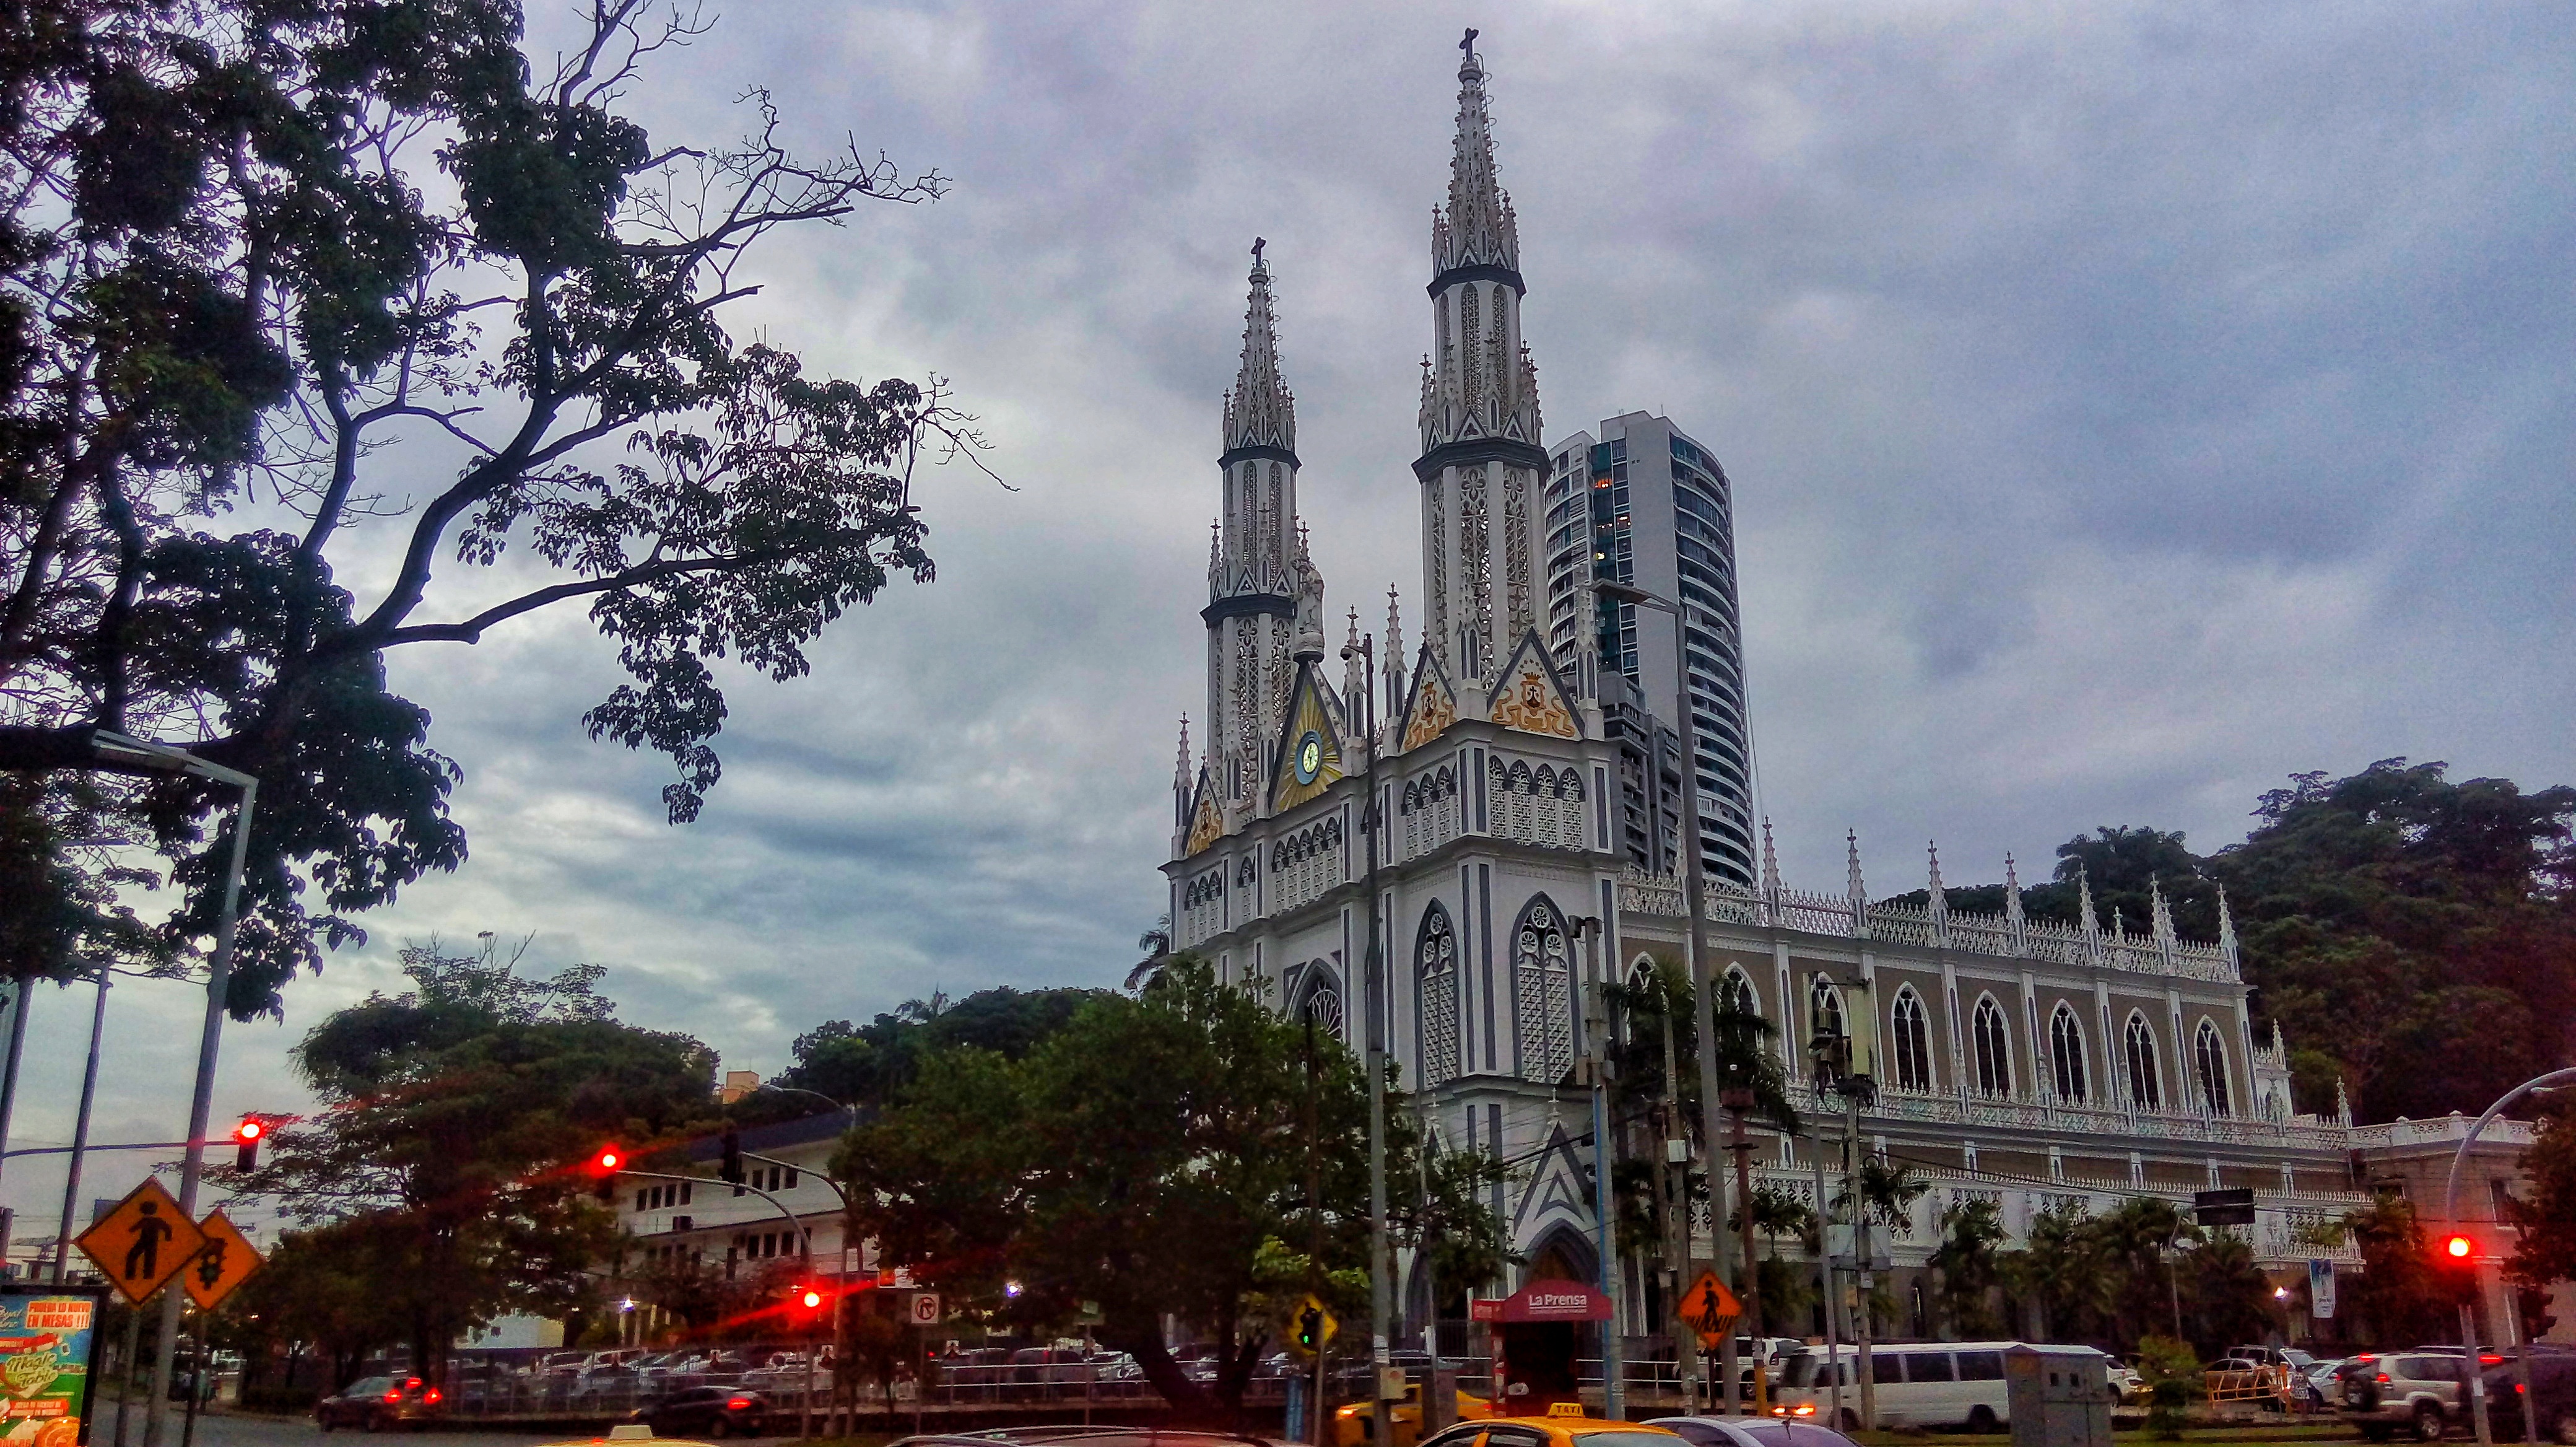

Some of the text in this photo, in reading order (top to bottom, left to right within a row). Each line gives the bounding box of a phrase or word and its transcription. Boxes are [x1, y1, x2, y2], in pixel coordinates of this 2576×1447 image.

[1529, 1294, 1587, 1306] La Prensa
[27, 1314, 40, 1327] EN
[41, 1314, 73, 1327] MESAS
